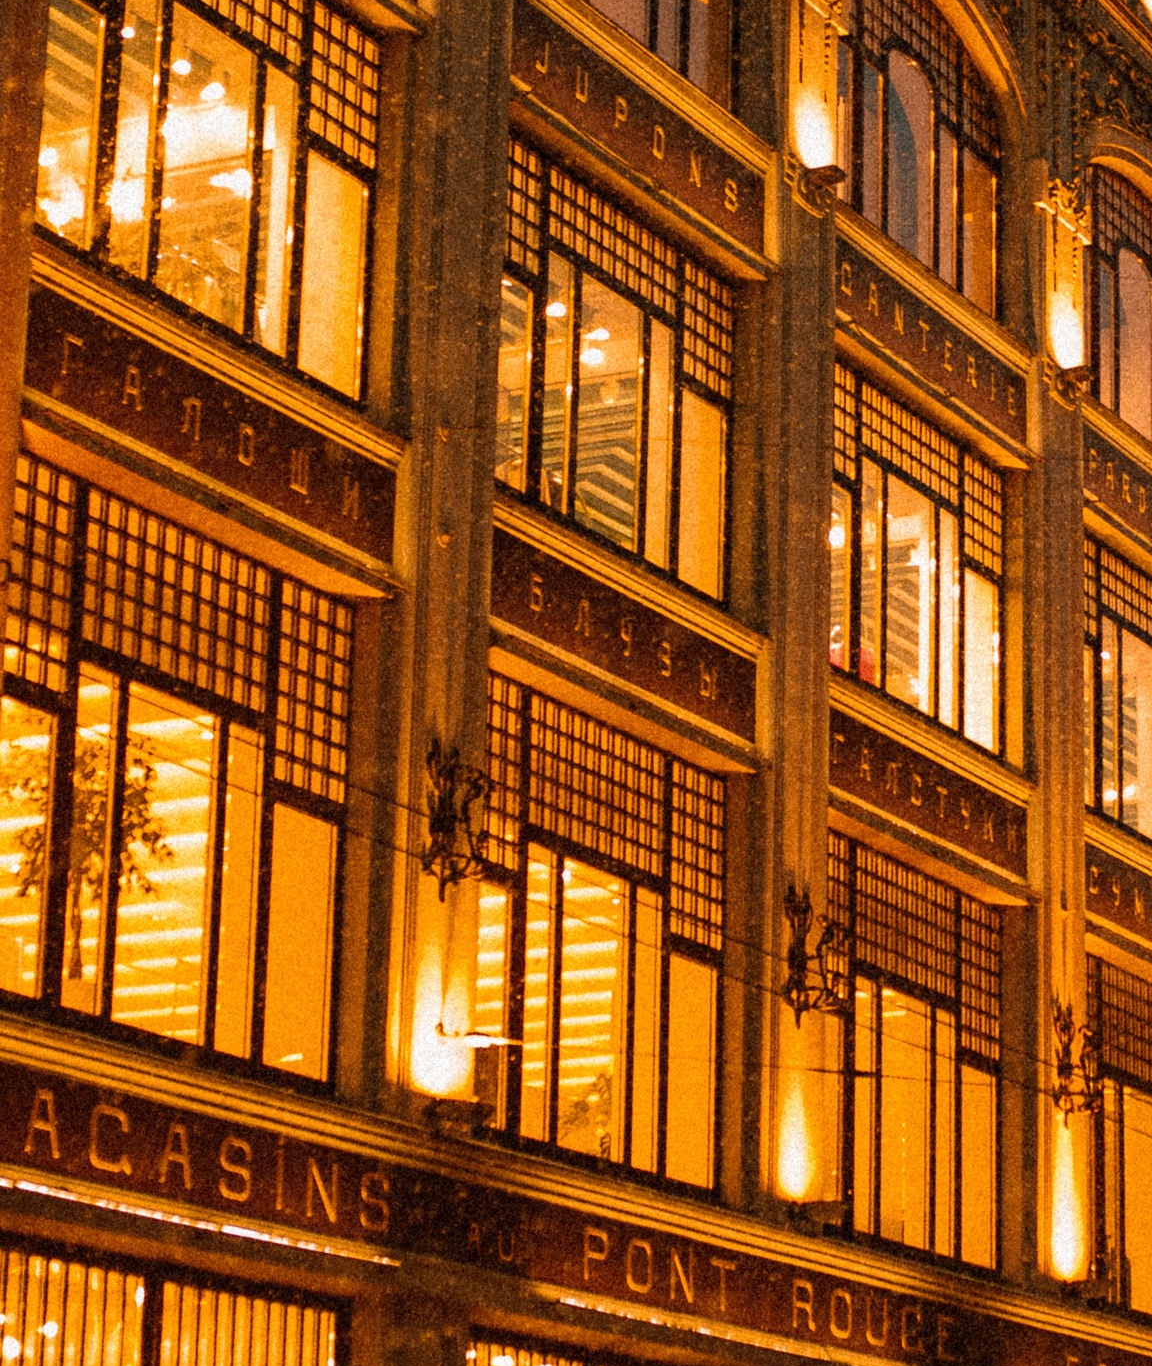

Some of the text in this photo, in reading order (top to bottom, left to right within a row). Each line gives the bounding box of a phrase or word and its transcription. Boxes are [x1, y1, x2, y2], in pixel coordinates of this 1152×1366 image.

[535, 41, 738, 213] JUPONS
[61, 336, 361, 521] ГАЛОШИ
[530, 572, 718, 700] БЛУЗЫ
[582, 1227, 736, 1312] PONT
[792, 1278, 955, 1361] ROUGE
